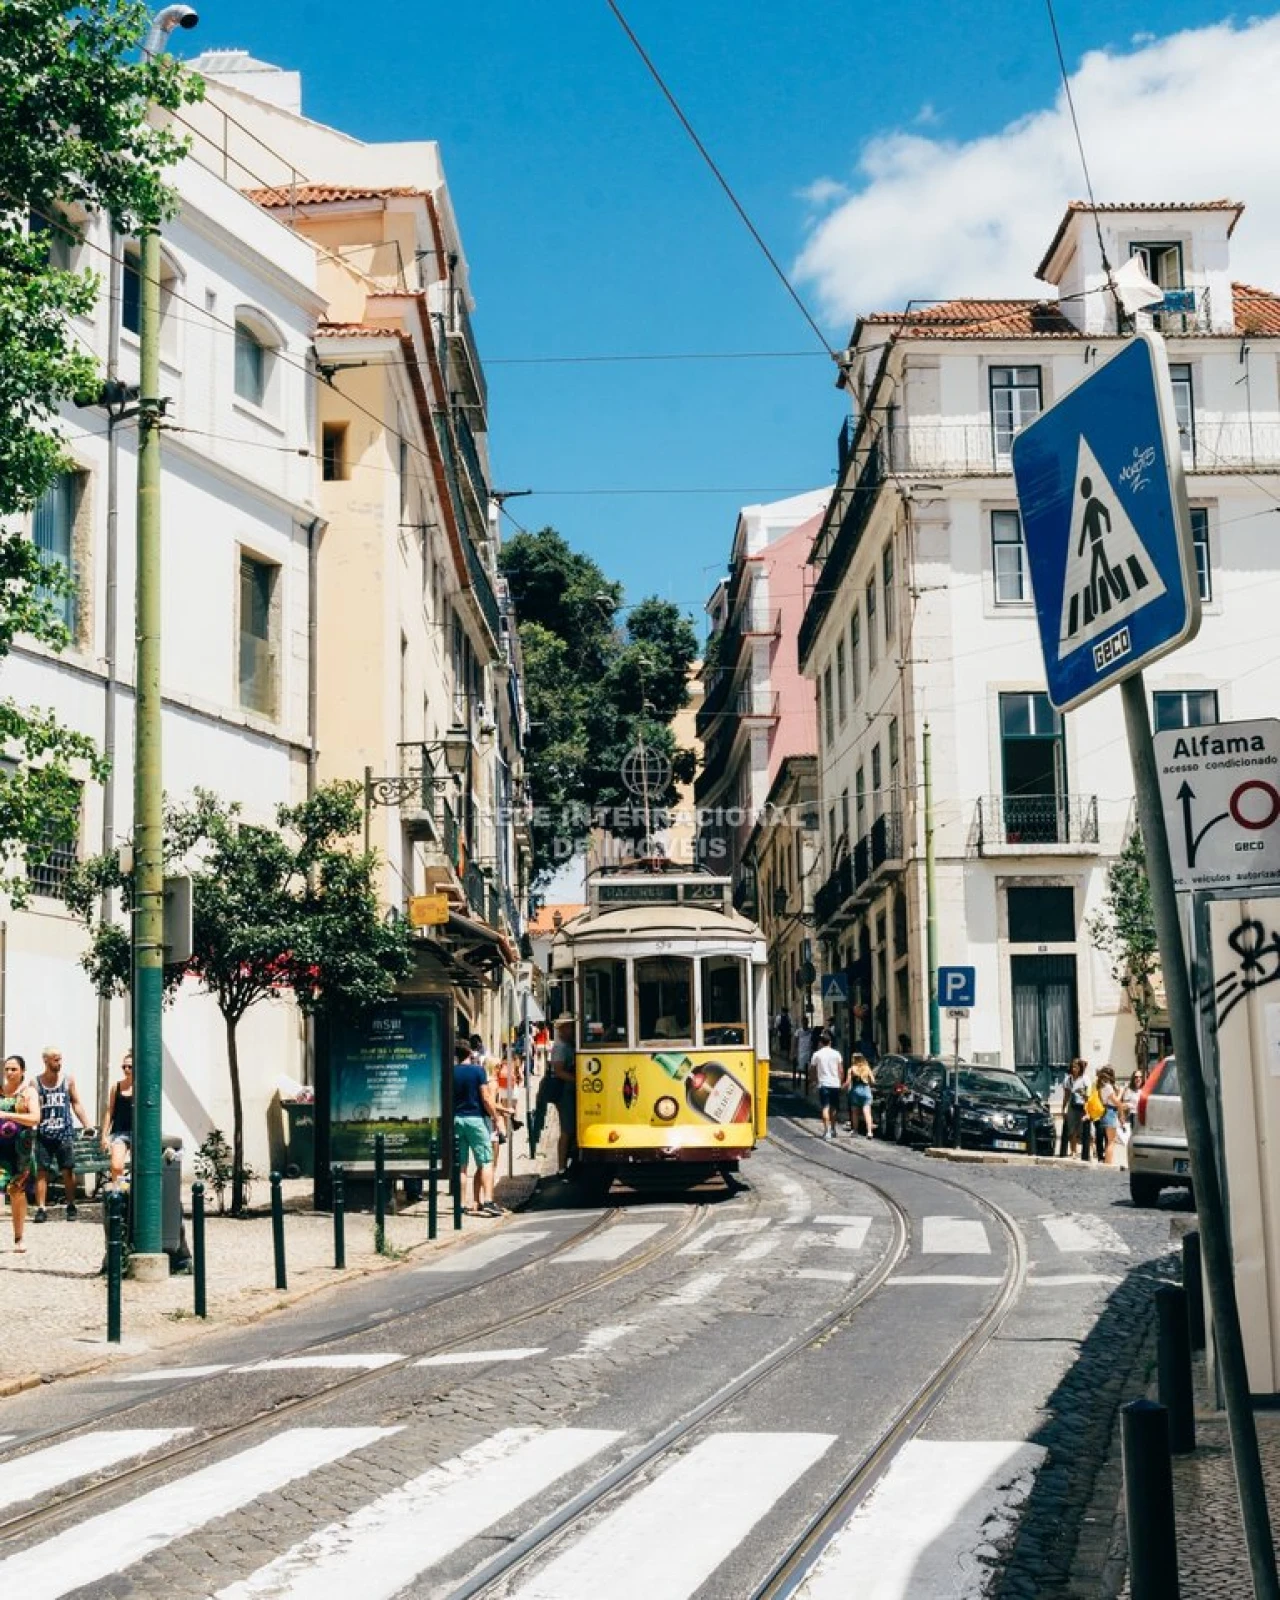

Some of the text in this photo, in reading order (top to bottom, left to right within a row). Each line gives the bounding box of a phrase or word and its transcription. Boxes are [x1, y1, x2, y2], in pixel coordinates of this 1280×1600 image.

[1173, 735, 1265, 759] Alfama
[1163, 755, 1278, 774] acesso condicionado
[692, 884, 715, 898] 28
[946, 972, 967, 1001] P
